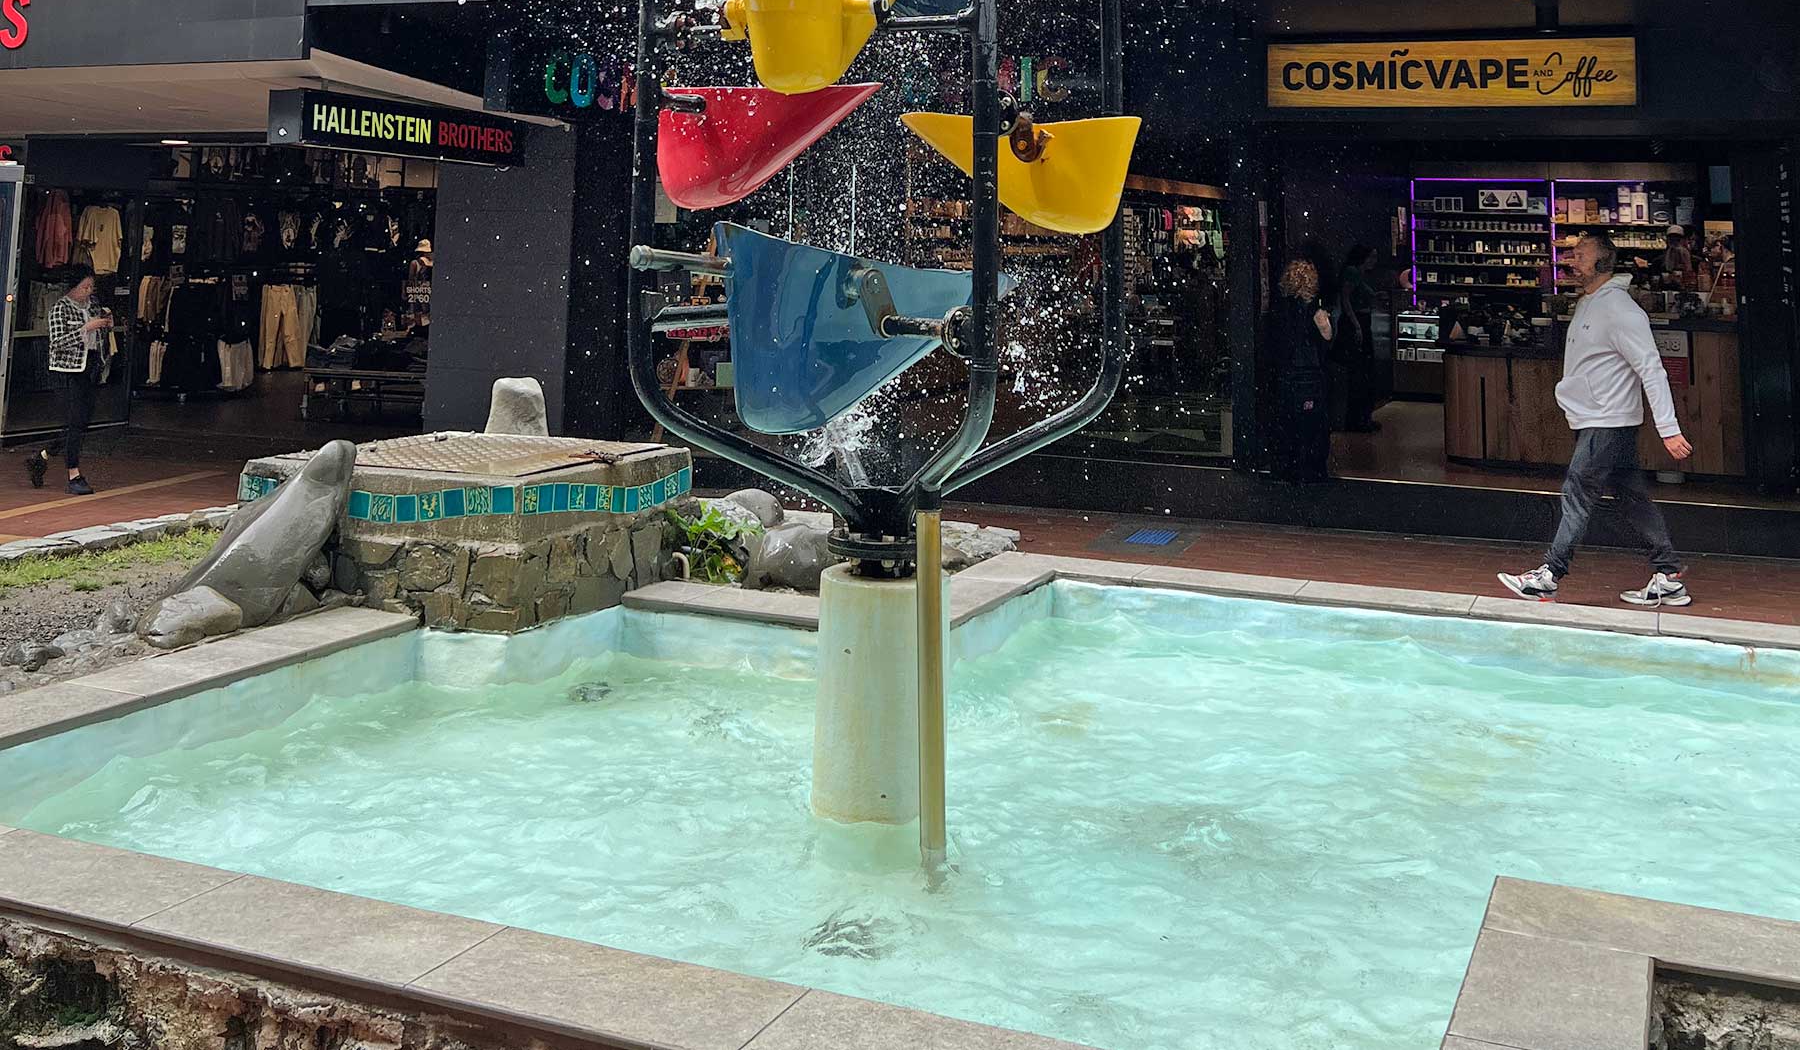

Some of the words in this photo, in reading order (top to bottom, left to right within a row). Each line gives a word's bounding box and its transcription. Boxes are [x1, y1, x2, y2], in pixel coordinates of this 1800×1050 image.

[1533, 69, 1553, 77] AND
[1536, 52, 1618, 97] Coffee
[313, 103, 432, 144] HALLENSTEIN
[438, 121, 513, 154] BROTHERS
